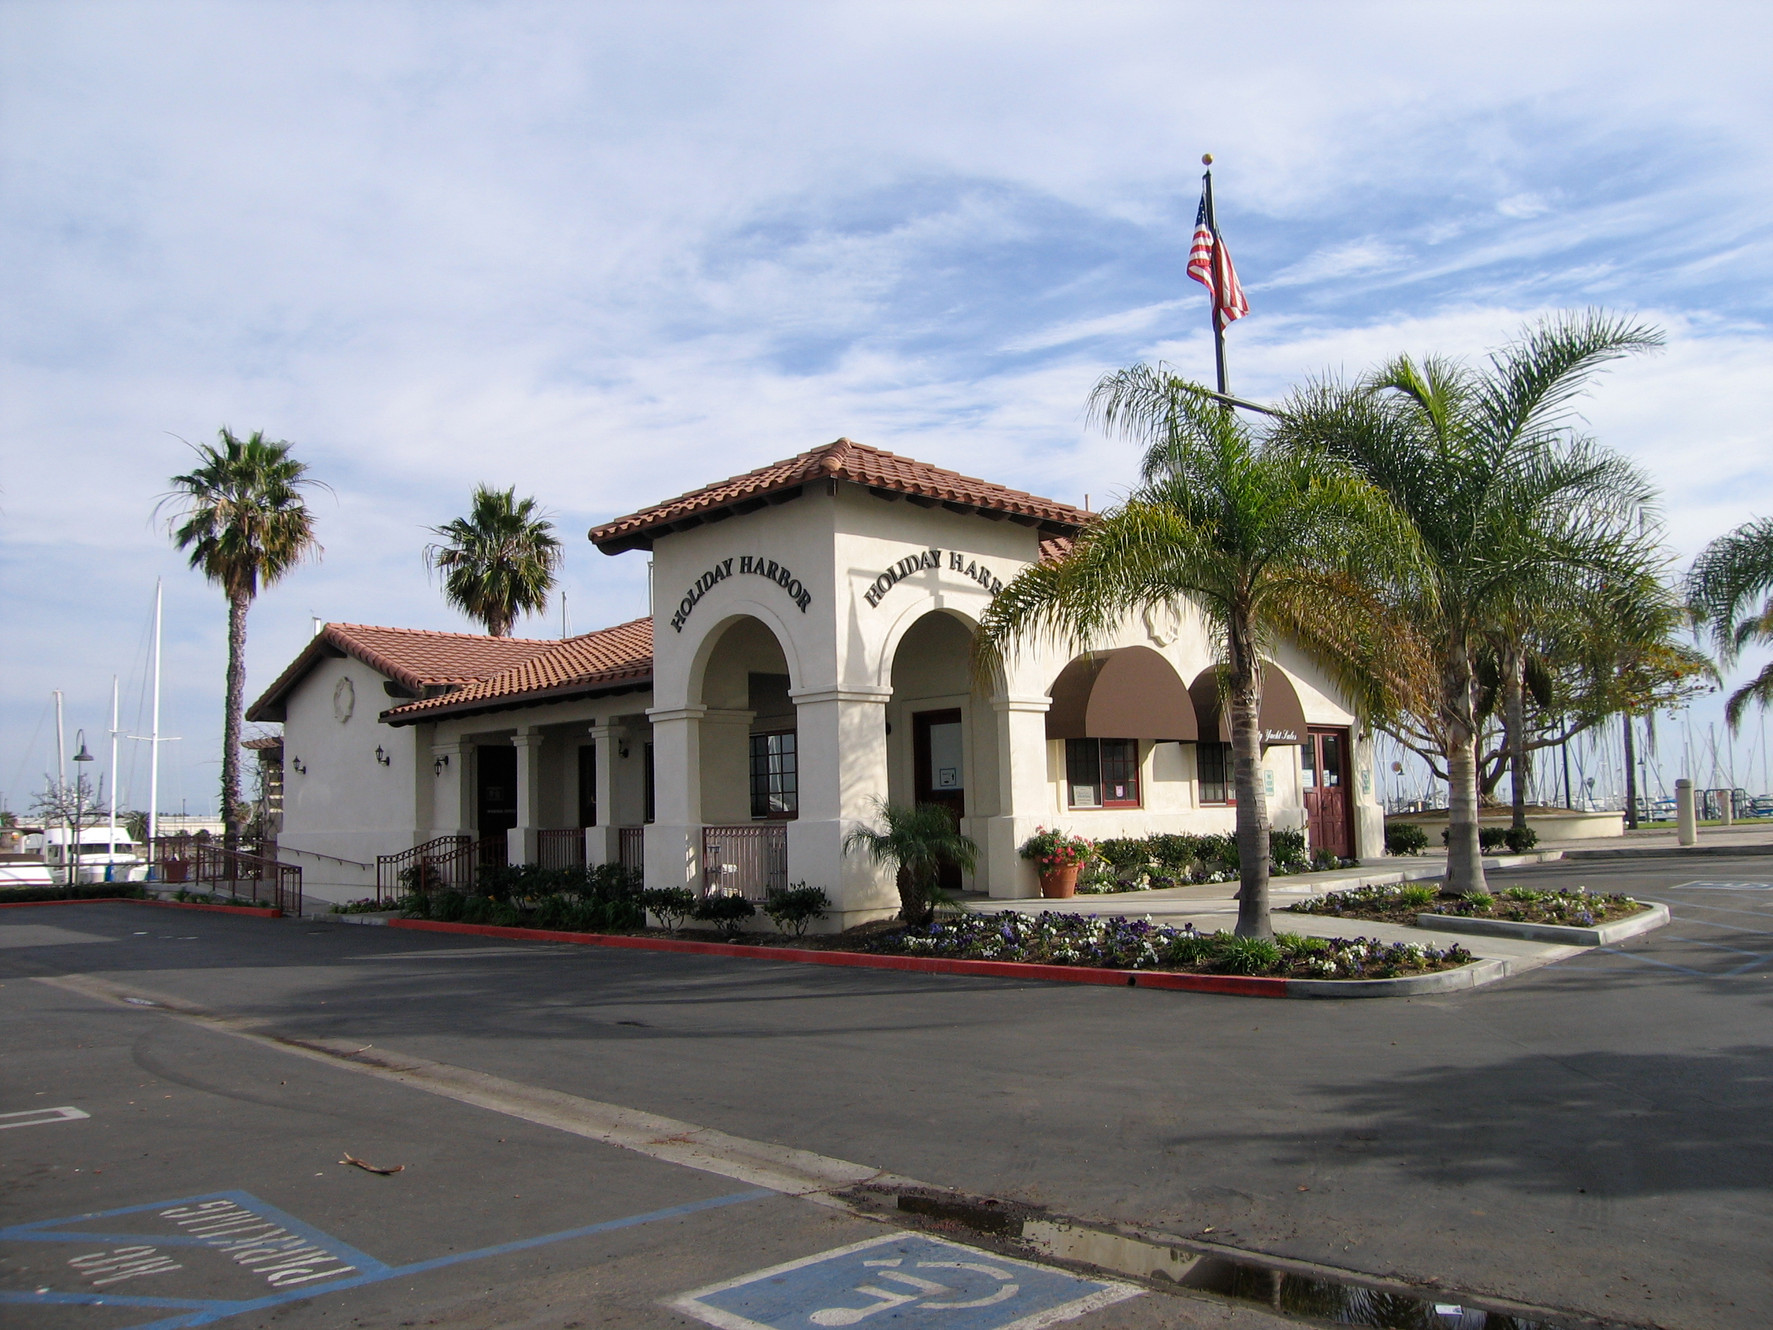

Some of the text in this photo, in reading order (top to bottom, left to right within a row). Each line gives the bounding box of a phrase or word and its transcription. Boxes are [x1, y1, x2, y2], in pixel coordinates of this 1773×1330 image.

[670, 556, 812, 633] HOLIDAY HARBOR
[863, 550, 1004, 609] HOLIDAY HARB
